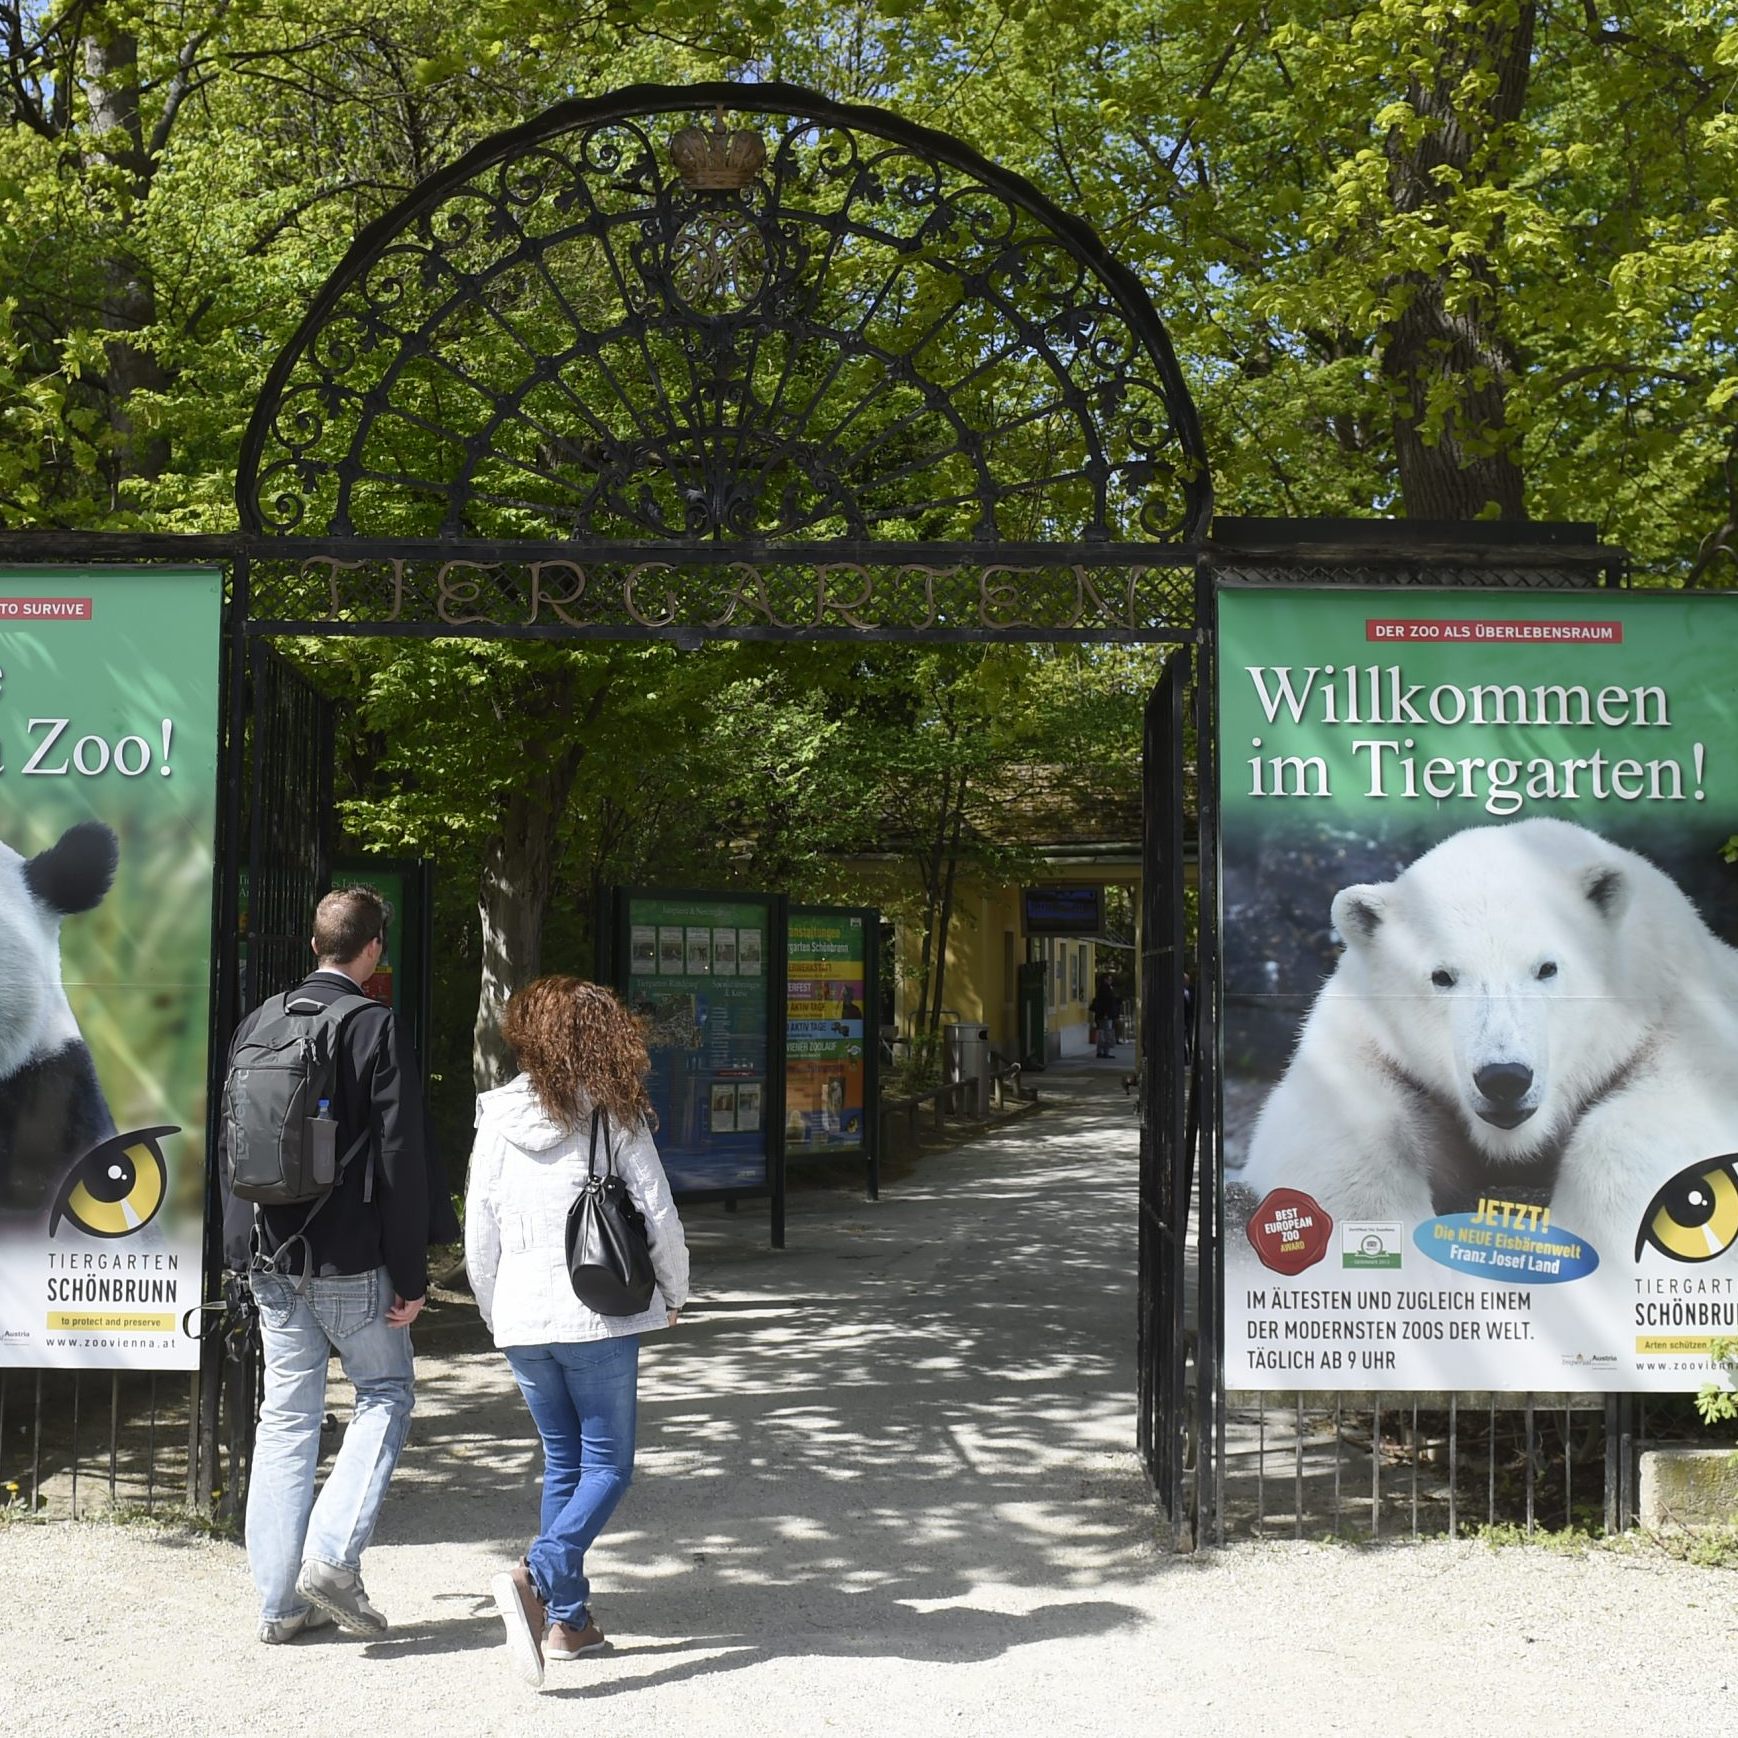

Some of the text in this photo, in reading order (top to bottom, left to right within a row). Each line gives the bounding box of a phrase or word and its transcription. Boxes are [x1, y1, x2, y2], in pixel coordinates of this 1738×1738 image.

[301, 554, 1147, 631] TIERGARTEN
[0, 603, 84, 615] TO SURVIVE
[1375, 624, 1613, 639] DER ZOO ALS ÜBERLEBENSRAUM
[1245, 665, 1671, 727] Willkommen
[21, 718, 173, 777] Zoo!
[1247, 737, 1705, 815] im Tiergarten!
[1274, 1207, 1298, 1221] BEST
[1470, 1198, 1550, 1234] JETZT!
[1264, 1216, 1313, 1234] EUROPEAN
[1281, 1229, 1300, 1242] ZOO
[1433, 1223, 1581, 1259] Die NEUE Eisbärenwelt
[1280, 1240, 1305, 1252] AWARD
[48, 1253, 178, 1270] TIERGARTEN
[1450, 1244, 1560, 1275] Franz Josef Land
[47, 1273, 178, 1303] SCHÖNBRUNN
[1634, 1278, 1734, 1294] TIERGART
[1247, 1286, 1531, 1310] IM ÄLTESTEN UND ZUGLEICH EINEM
[1635, 1297, 1738, 1326] SCHÖNBRU
[61, 1317, 161, 1329] to protect and preserve
[1247, 1320, 1535, 1340] DER MODERNSTEN ZOOS DER WELT.
[46, 1337, 176, 1349] www.zoovienna.at
[1645, 1341, 1667, 1349] Arten
[1670, 1340, 1707, 1350] schützen
[1247, 1346, 1396, 1370] TÄGLICH AB 9 UHR
